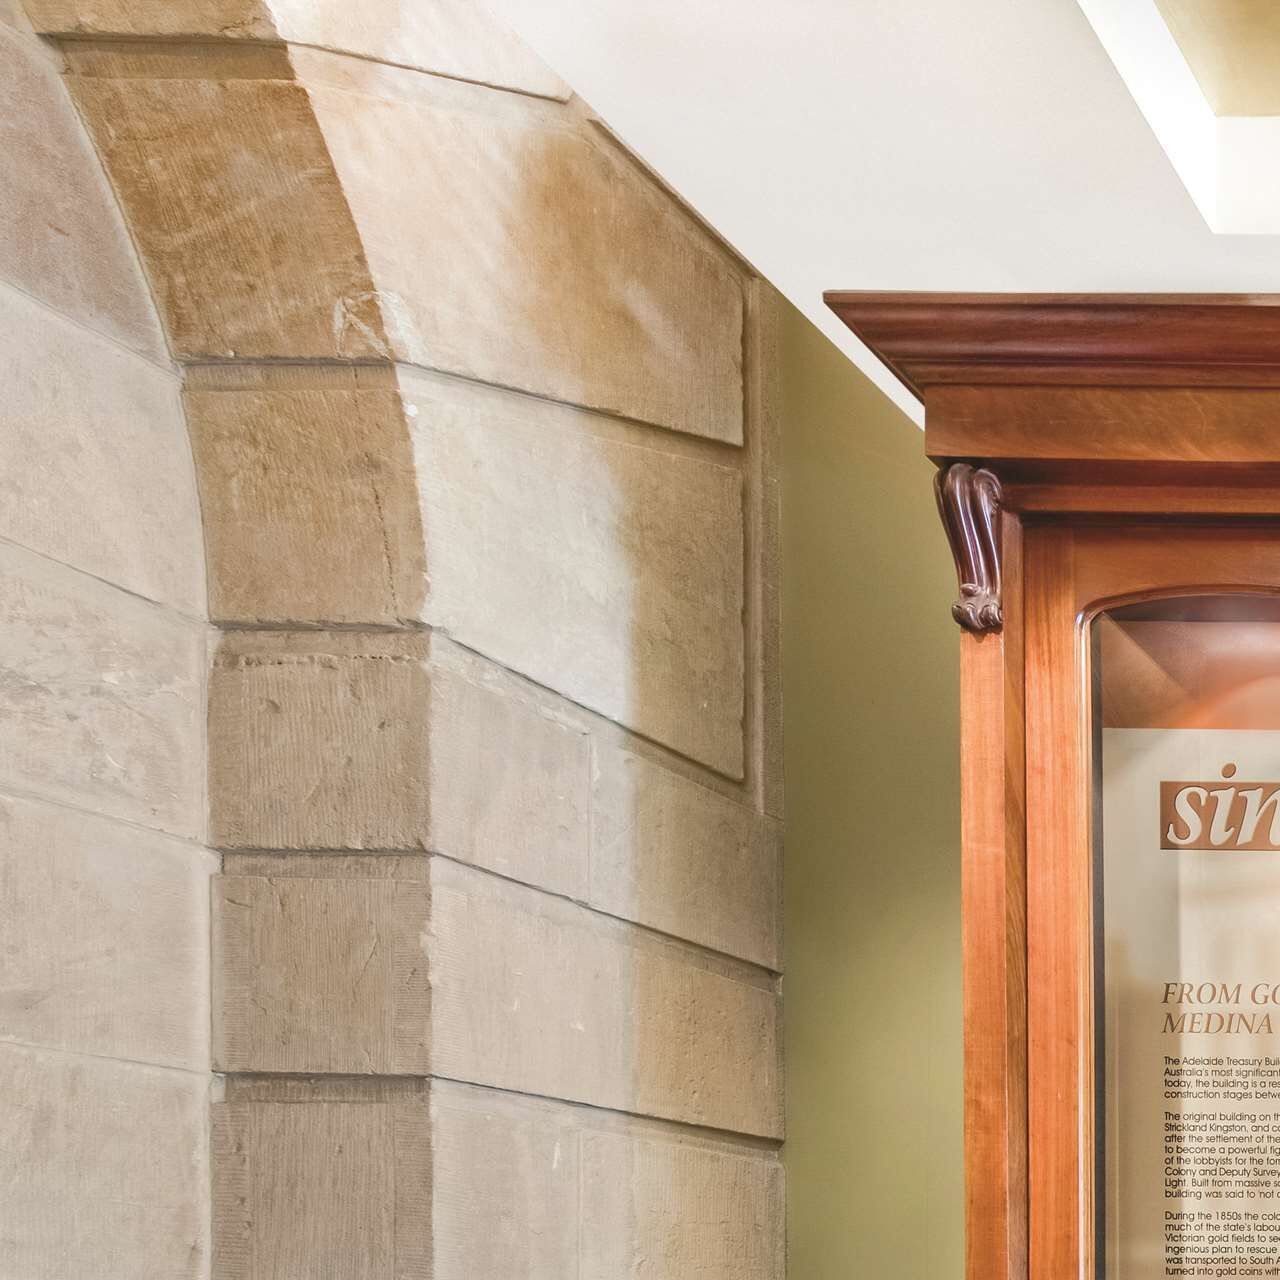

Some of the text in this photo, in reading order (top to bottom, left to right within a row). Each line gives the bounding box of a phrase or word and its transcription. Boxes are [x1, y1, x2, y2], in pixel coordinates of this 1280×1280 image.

[1160, 982, 1242, 1005] FROM
[1161, 1012, 1273, 1034] MEDINA
[1164, 1057, 1180, 1066] The
[1182, 1057, 1226, 1066] Adelaide
[1225, 1057, 1264, 1068] Treasury
[1195, 1079, 1210, 1088] the
[1211, 1079, 1249, 1090] building
[1250, 1079, 1258, 1088] is
[1164, 1091, 1221, 1099] construction
[1222, 1091, 1252, 1101] stages
[1164, 1211, 1195, 1222] During
[1197, 1211, 1212, 1220] the
[1215, 1211, 1242, 1220] 1850s
[1244, 1211, 1259, 1220] the
